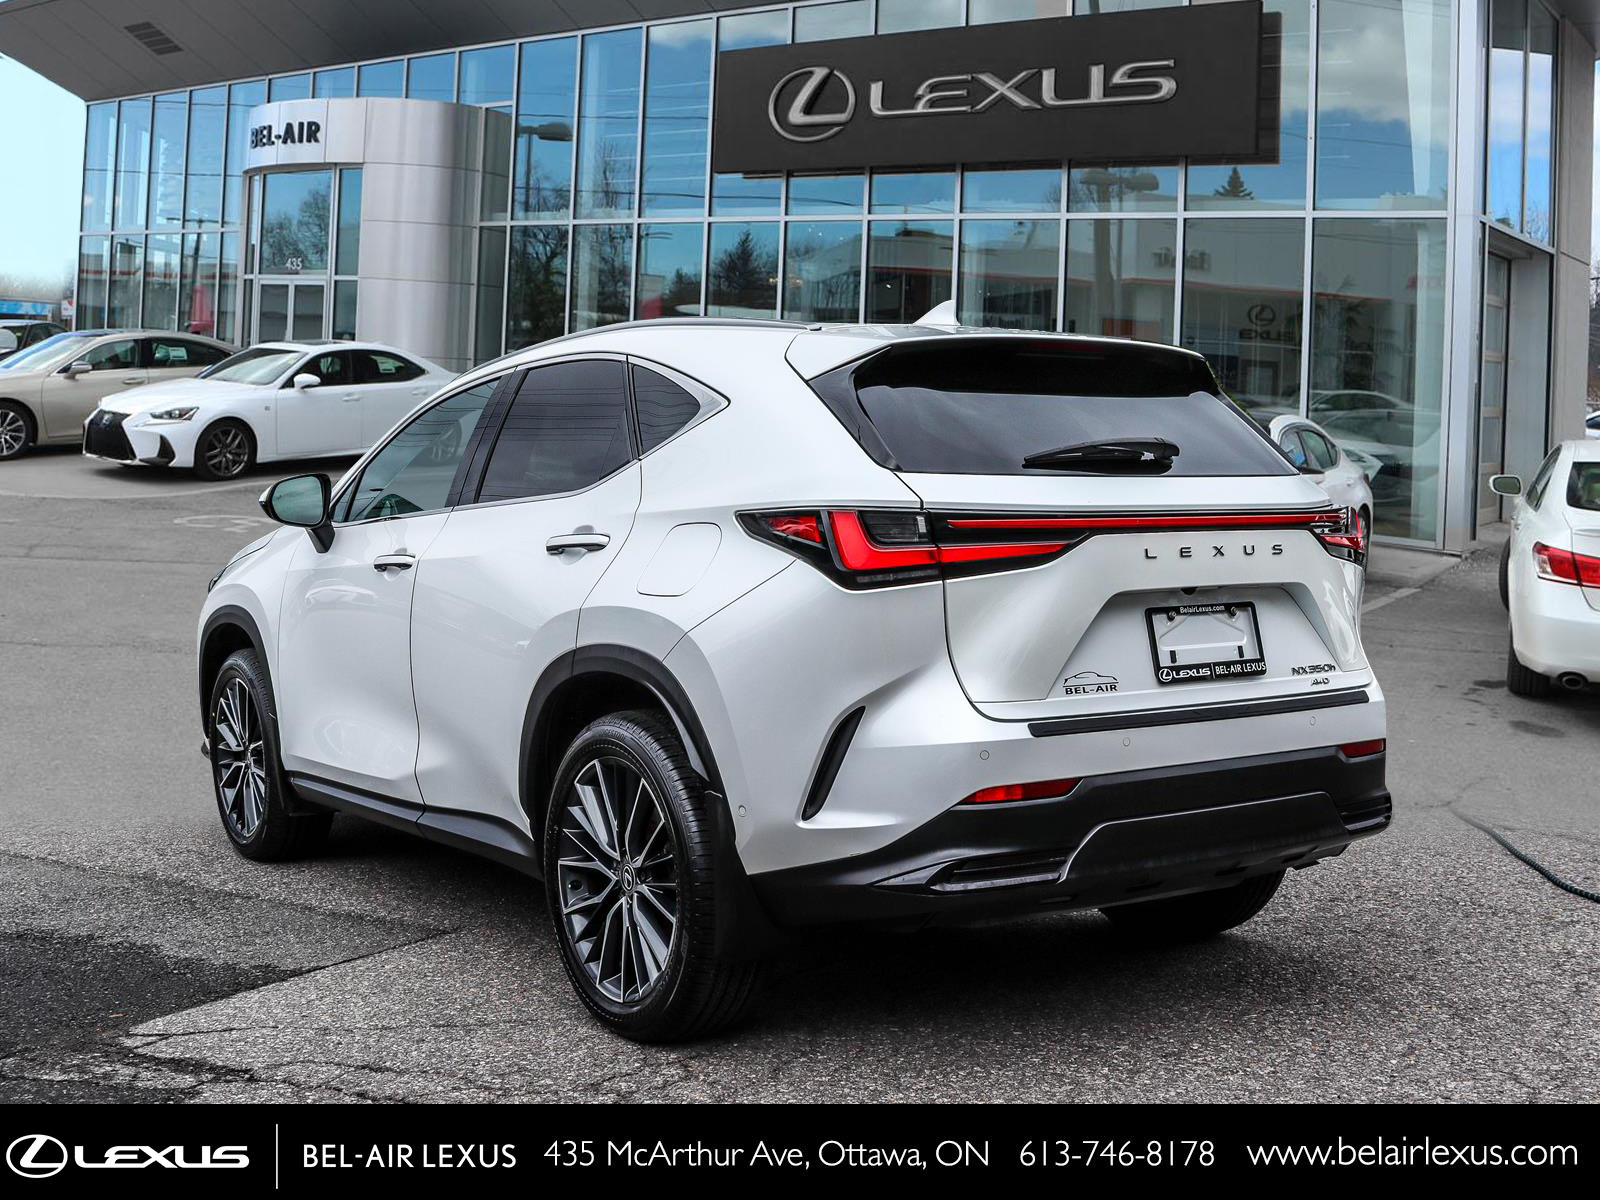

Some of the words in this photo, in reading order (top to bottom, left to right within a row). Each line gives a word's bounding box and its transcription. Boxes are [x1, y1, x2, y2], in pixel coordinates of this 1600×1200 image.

[868, 59, 1178, 118] LEXUS
[250, 121, 321, 149] BEL-AIR
[285, 257, 303, 270] 435
[1144, 544, 1284, 560] LEXUS
[1179, 604, 1226, 614] BelairLexus.com
[1172, 667, 1211, 679] LEXUS
[1215, 663, 1242, 676] BEL-AIR
[1243, 661, 1266, 673] LEXUS
[1065, 684, 1118, 695] BEL-AIR
